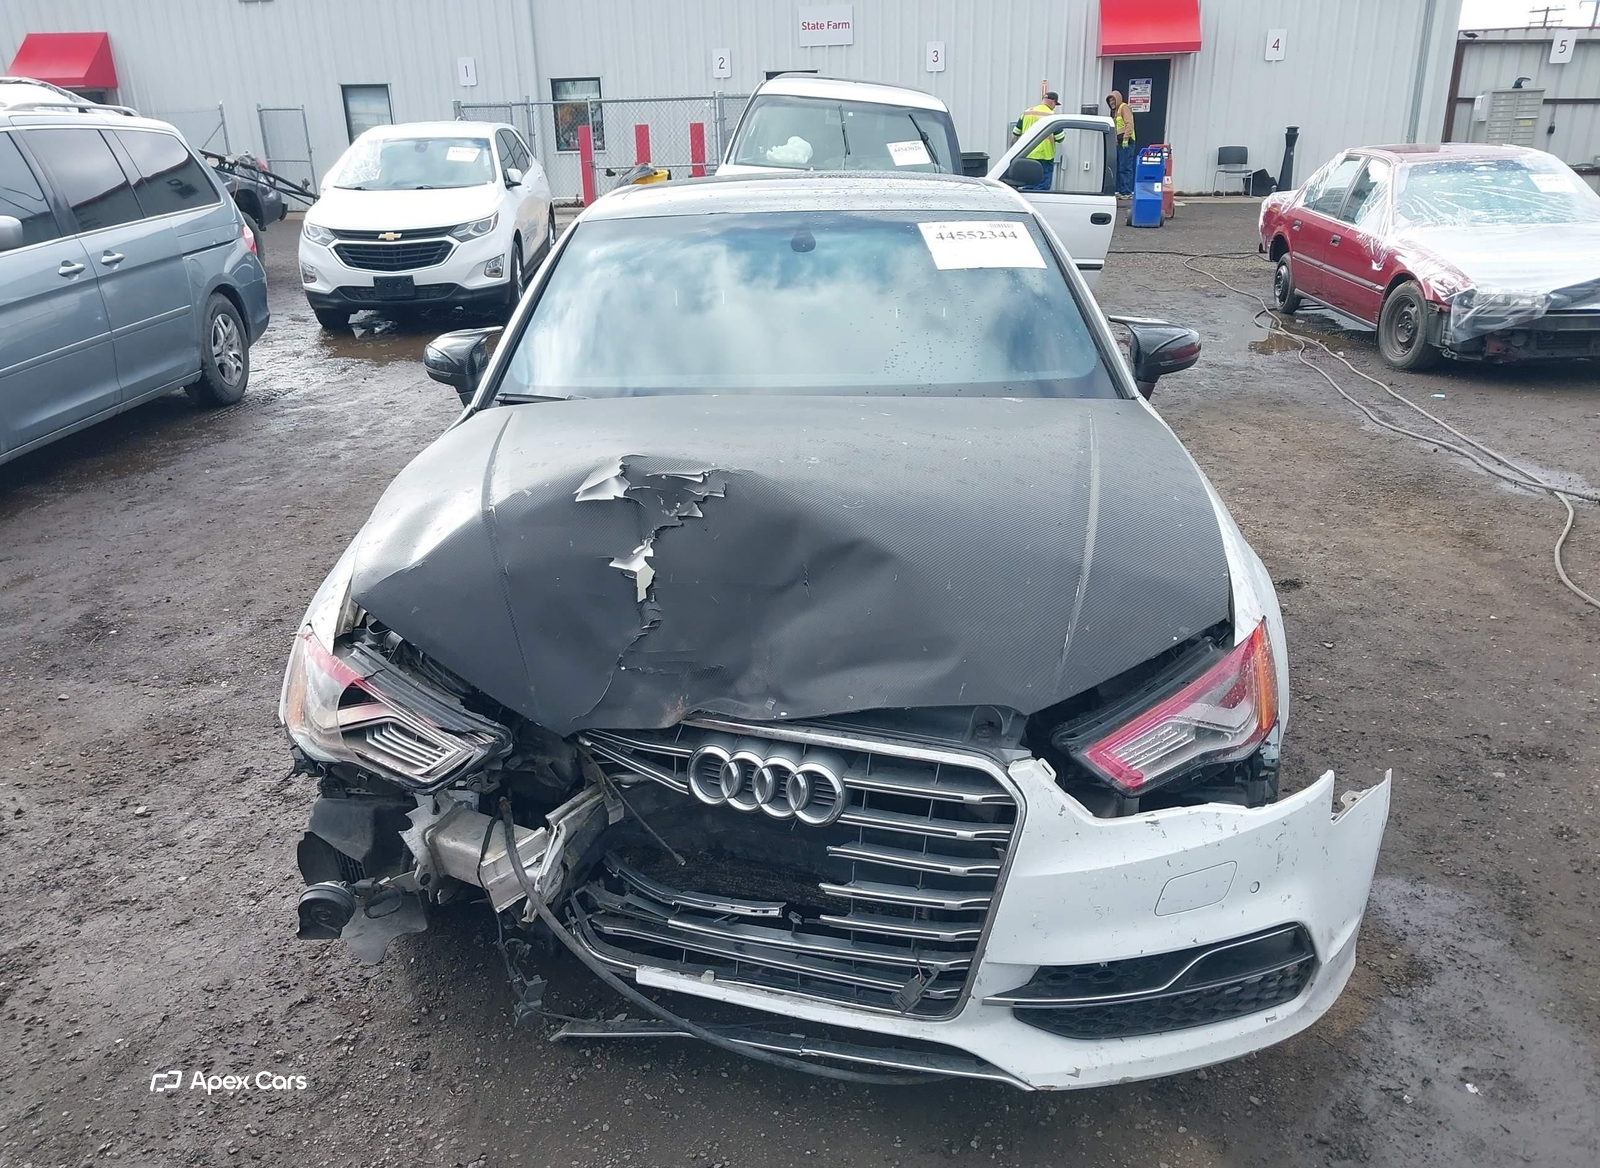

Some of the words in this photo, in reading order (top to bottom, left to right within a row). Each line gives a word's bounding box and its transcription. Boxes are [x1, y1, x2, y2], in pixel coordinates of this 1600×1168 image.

[801, 21, 825, 31] State
[826, 20, 850, 30] Farm
[1271, 37, 1280, 52] 4
[1558, 39, 1568, 54] 5
[718, 56, 725, 70] 2
[932, 49, 939, 63] 3
[464, 65, 469, 78] 1
[935, 230, 1018, 241] 44552344
